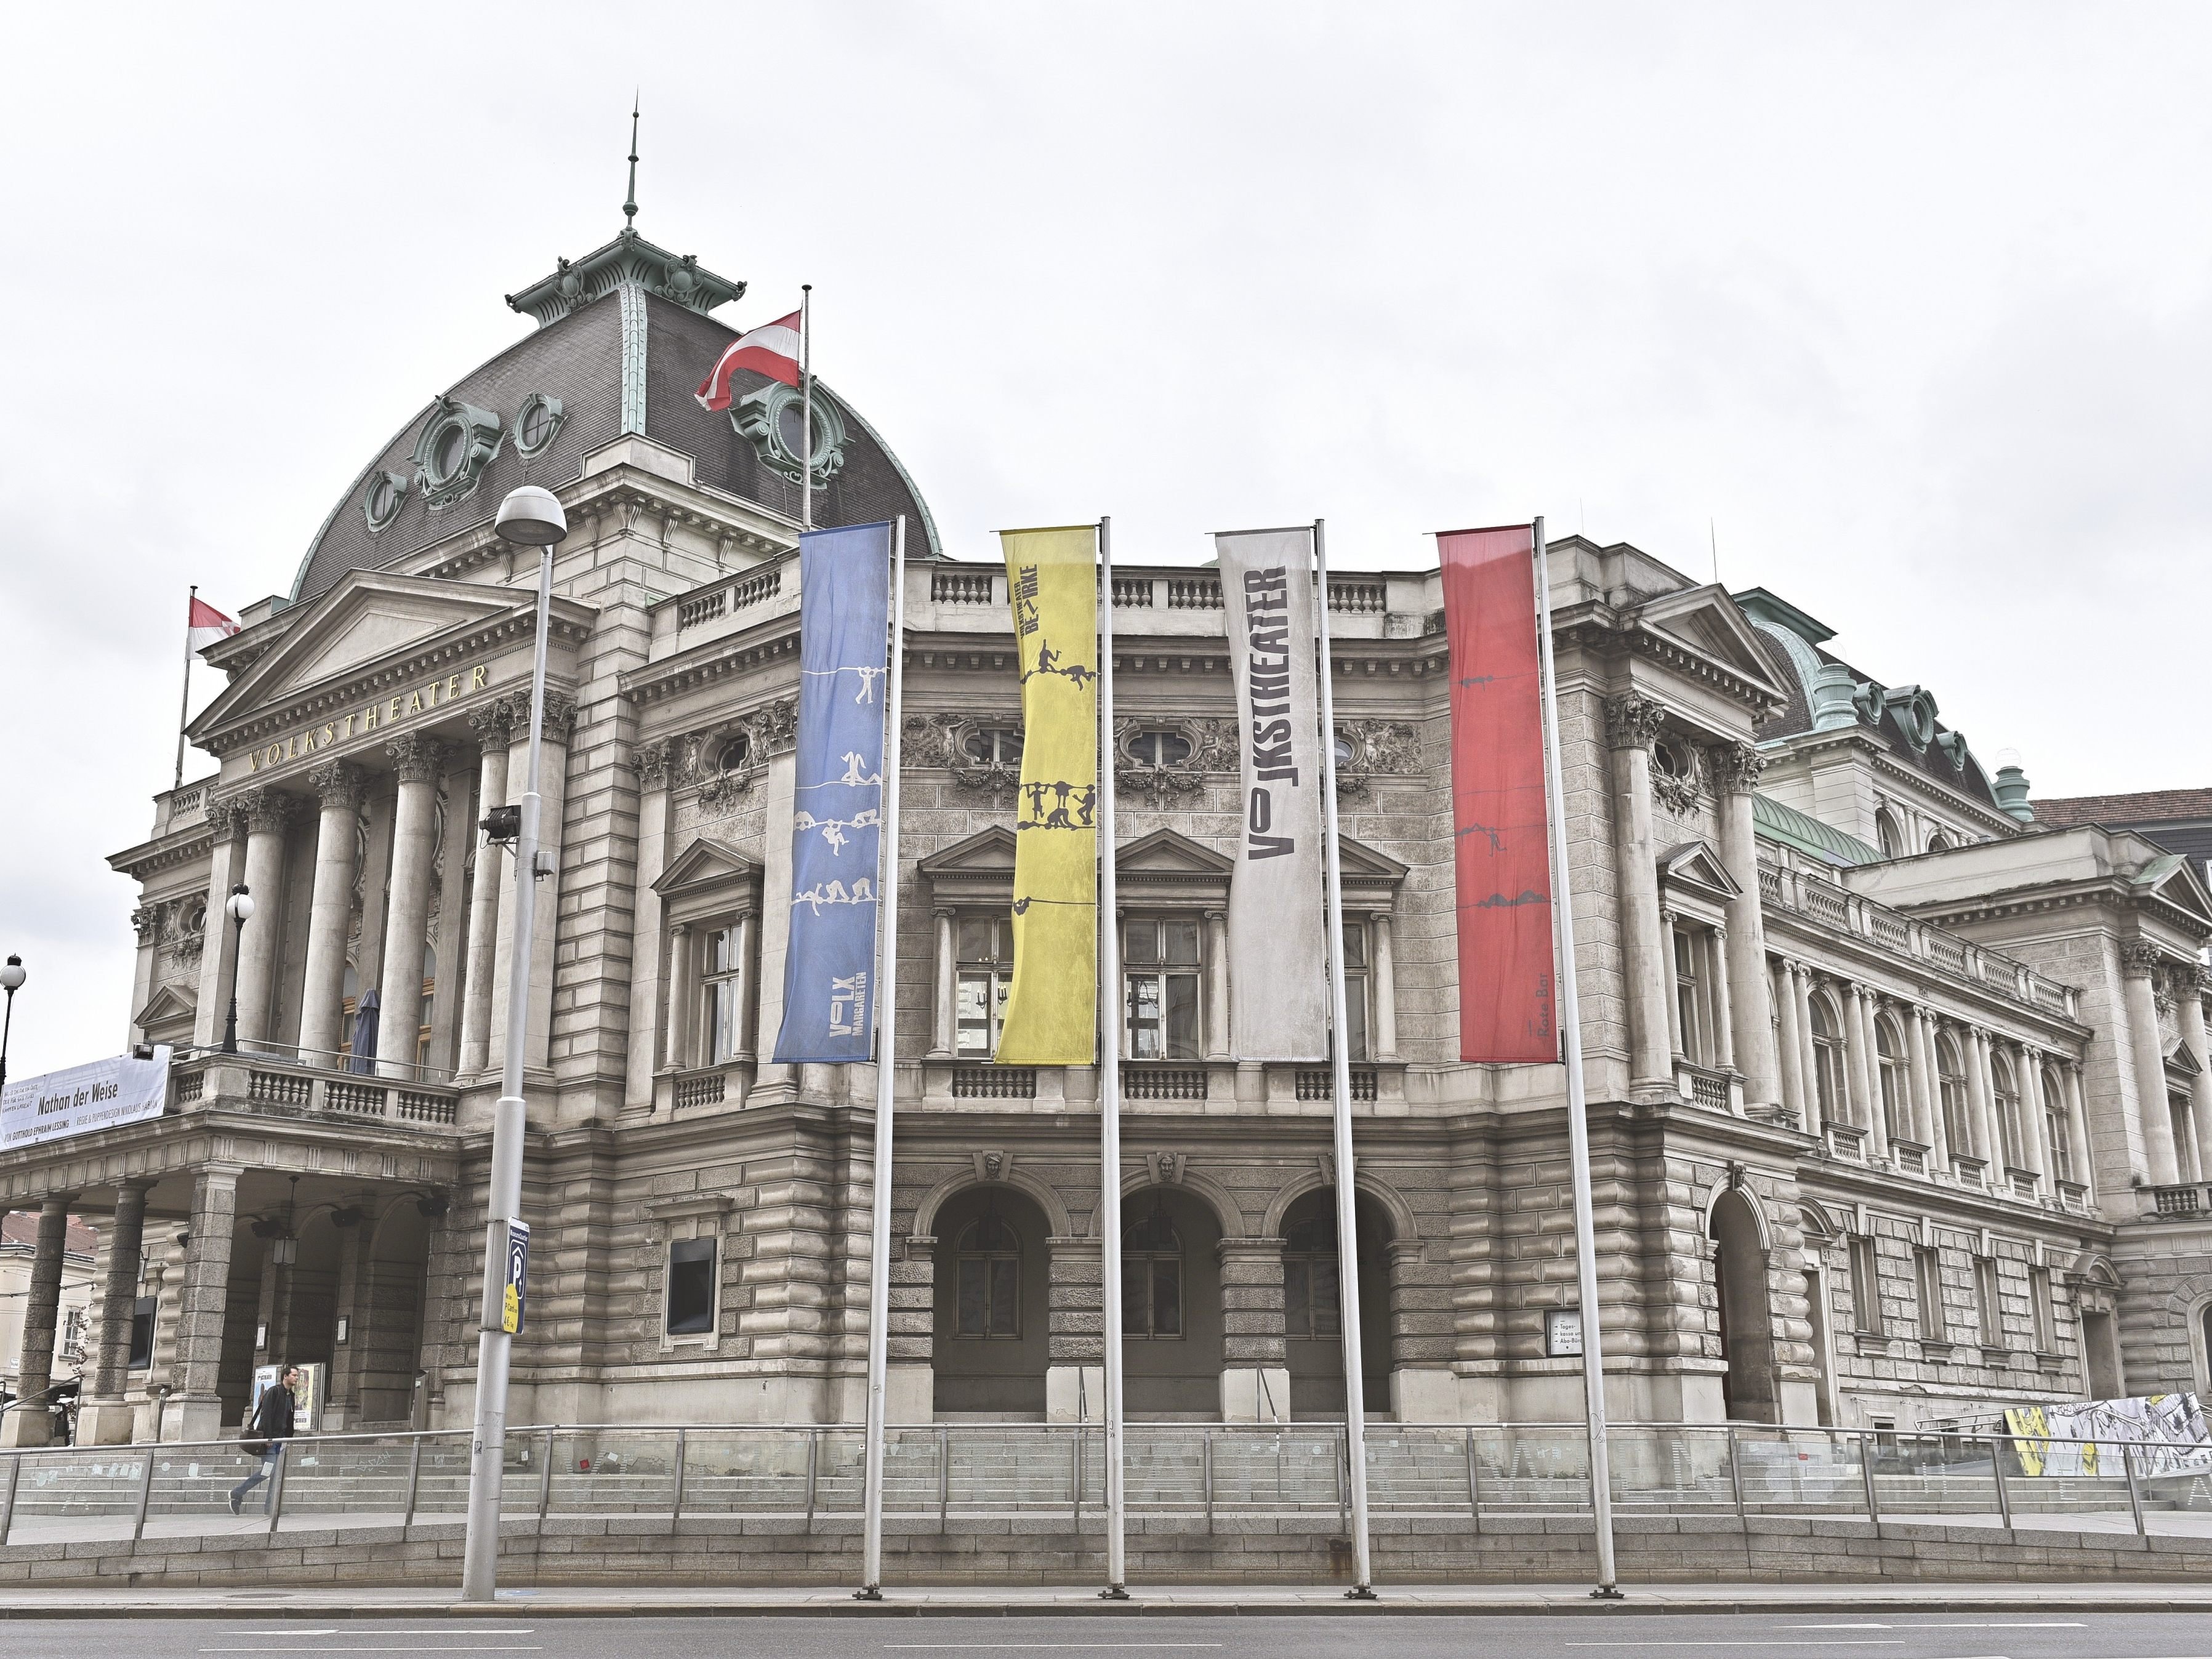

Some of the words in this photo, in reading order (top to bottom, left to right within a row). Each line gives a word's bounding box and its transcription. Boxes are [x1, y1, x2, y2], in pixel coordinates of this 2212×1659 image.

[249, 664, 489, 773] VOLKSTHEATER
[1243, 564, 1299, 861] VOLKSTHEATER
[1536, 973, 1548, 997] Bar
[829, 976, 855, 1038] VOLX
[851, 971, 867, 1036] MARGARETEN
[1537, 1003, 1550, 1037] Rote
[38, 1093, 70, 1116] Nathan
[73, 1087, 89, 1107] der
[92, 1080, 118, 1103] Weise
[12, 1128, 33, 1141] GOTTHOLD
[33, 1123, 52, 1136] EPHRAIM
[52, 1119, 70, 1131] LESSING
[513, 1255, 521, 1285] P
